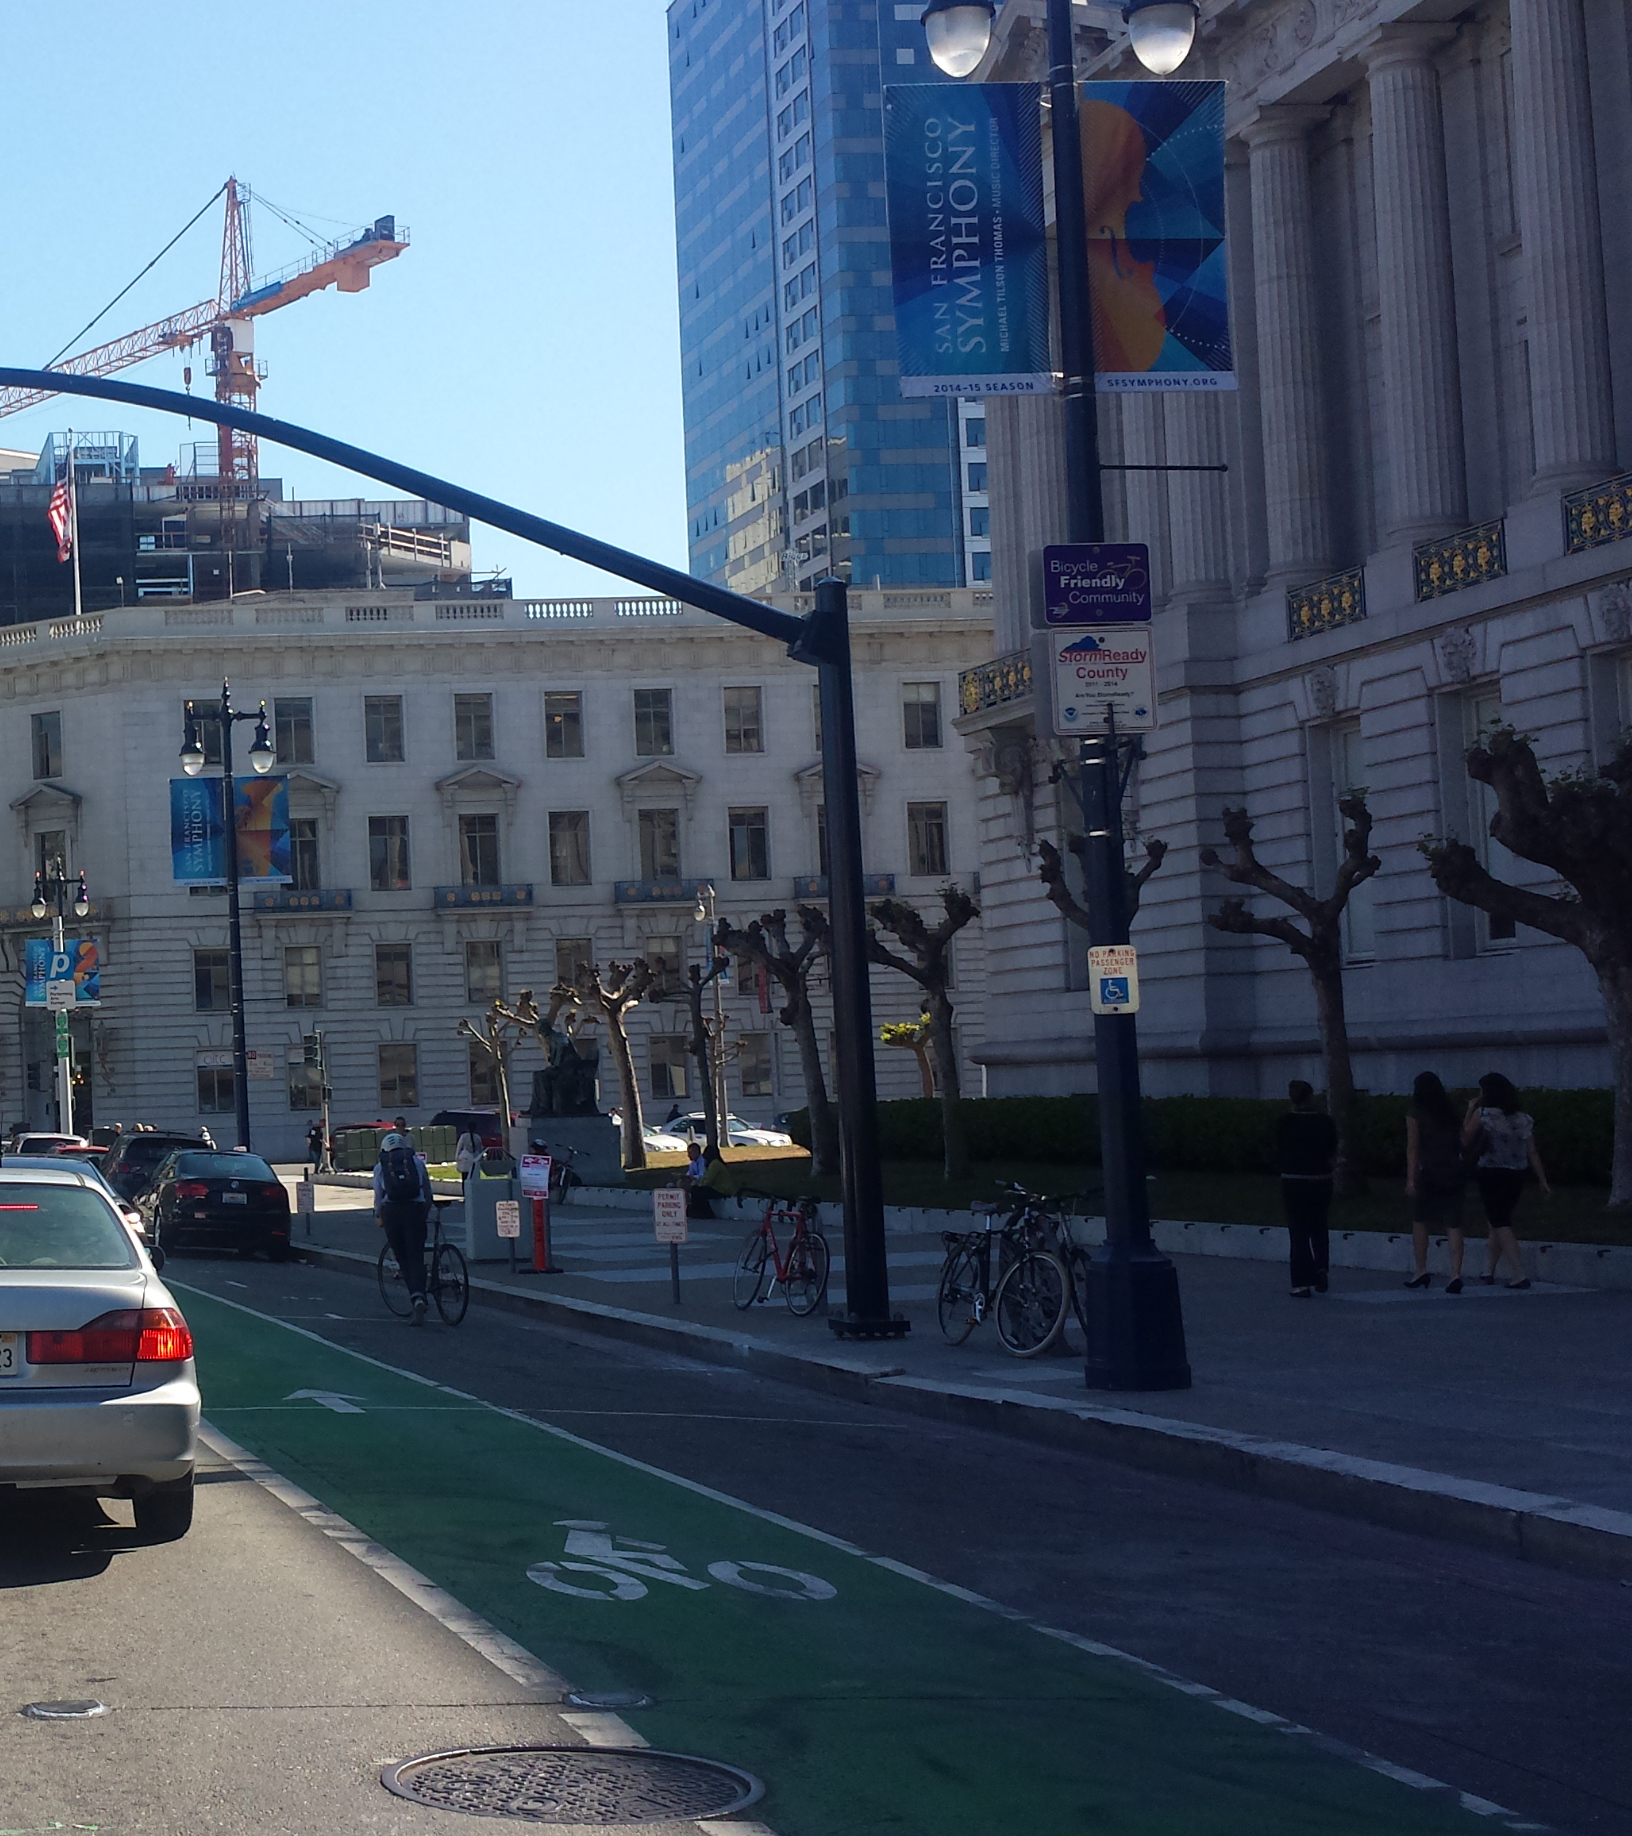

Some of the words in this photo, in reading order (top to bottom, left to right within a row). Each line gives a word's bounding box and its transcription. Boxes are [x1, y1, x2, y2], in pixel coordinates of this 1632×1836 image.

[989, 117, 999, 169] DIRECTOR
[991, 174, 1002, 208] MUSIC
[925, 117, 948, 286] FRANCISCO
[948, 117, 986, 353] SYMPHONY
[992, 216, 1003, 262] THOMAS
[995, 266, 1007, 301] TILSON
[933, 302, 953, 353] SAN
[998, 304, 1010, 352] MICHAEL
[933, 383, 981, 393] 2014-15
[985, 381, 1034, 392] SEASON
[1107, 377, 1218, 388] SFSYMPHONY.ORG
[1050, 560, 1099, 574] Bicycle
[1060, 575, 1125, 589] Friendly
[1069, 591, 1144, 605] Community
[1058, 649, 1147, 664] StormReady
[1076, 666, 1128, 681] County
[191, 790, 204, 872] SYMPHONY
[1089, 950, 1099, 959] NO
[1103, 948, 1135, 958] PARKING
[1091, 958, 1134, 968] PASSENGER
[1103, 966, 1123, 976] ZONE
[658, 1193, 680, 1201] PERMIT
[657, 1201, 681, 1209] PARKING
[661, 1210, 678, 1218] ONLY
